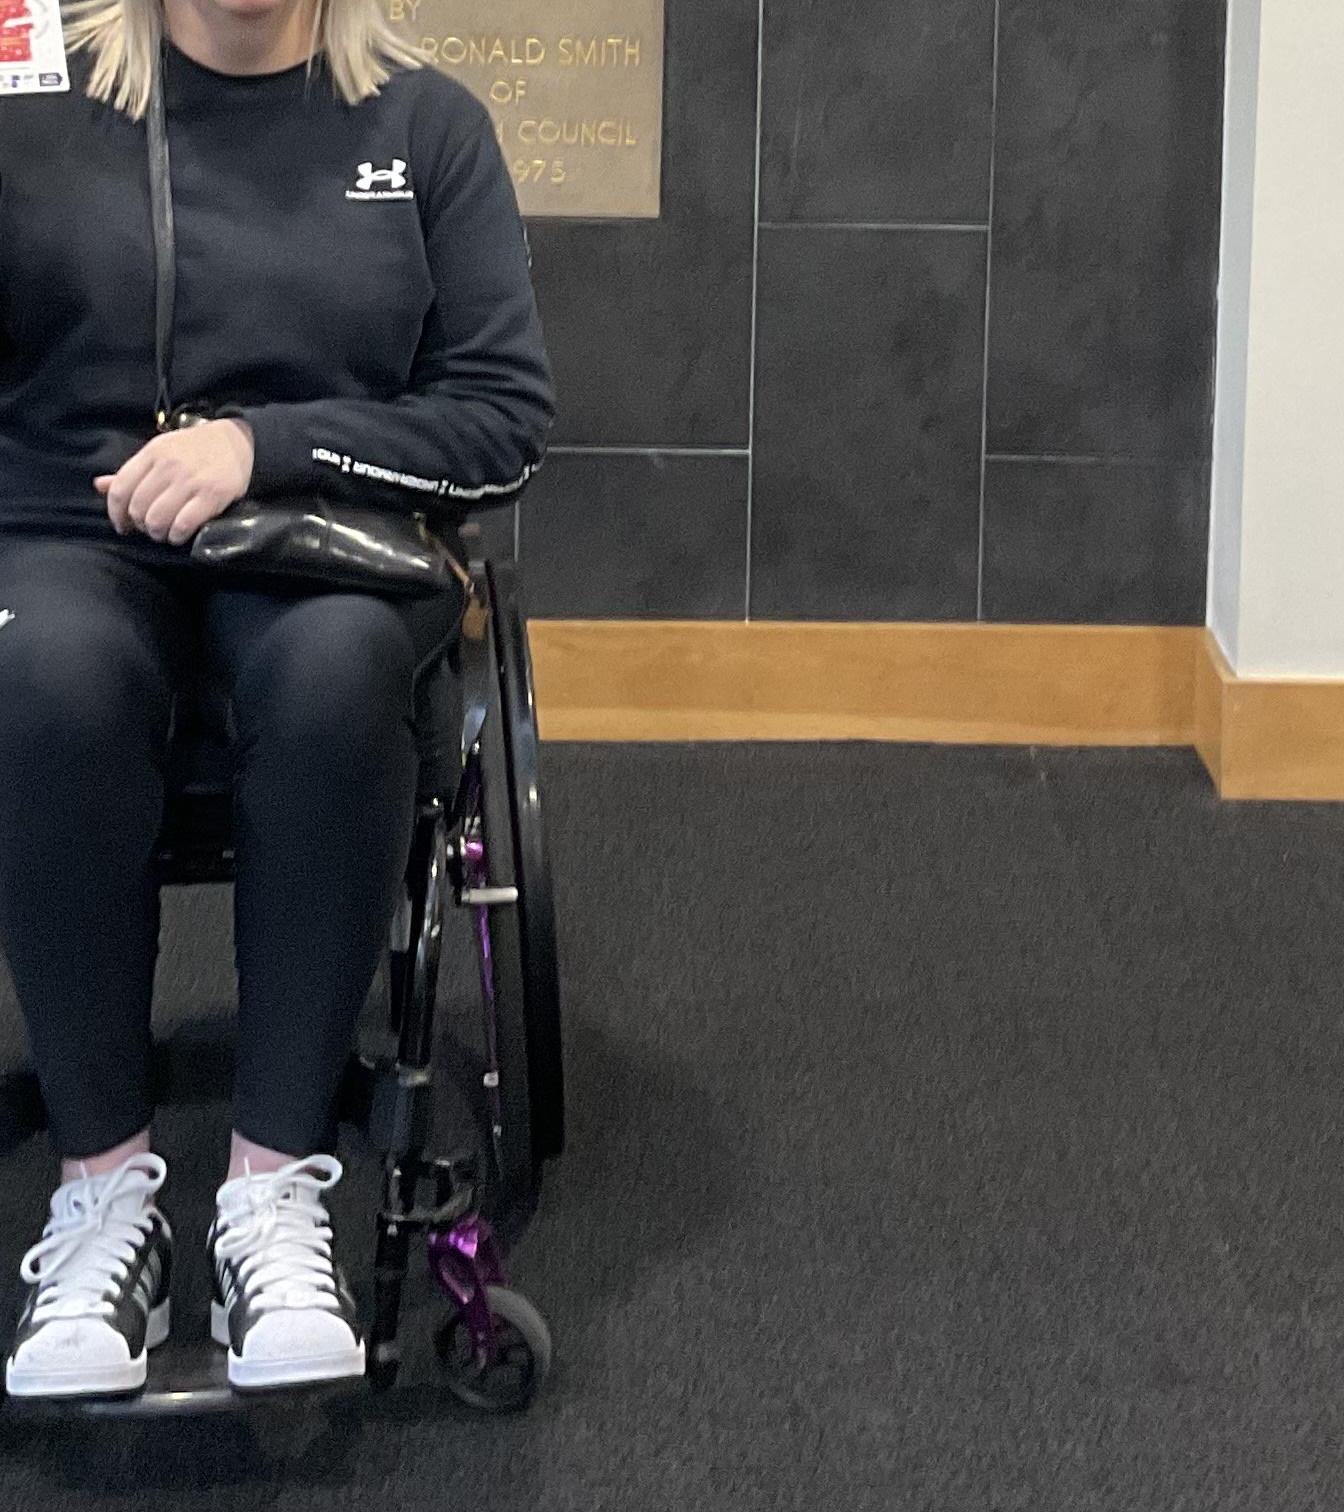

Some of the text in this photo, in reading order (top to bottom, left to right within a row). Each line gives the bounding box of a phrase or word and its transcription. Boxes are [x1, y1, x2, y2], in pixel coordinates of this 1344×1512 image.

[558, 38, 641, 67] SMITH
[489, 80, 528, 105] OF
[517, 120, 637, 147] COUNCIL
